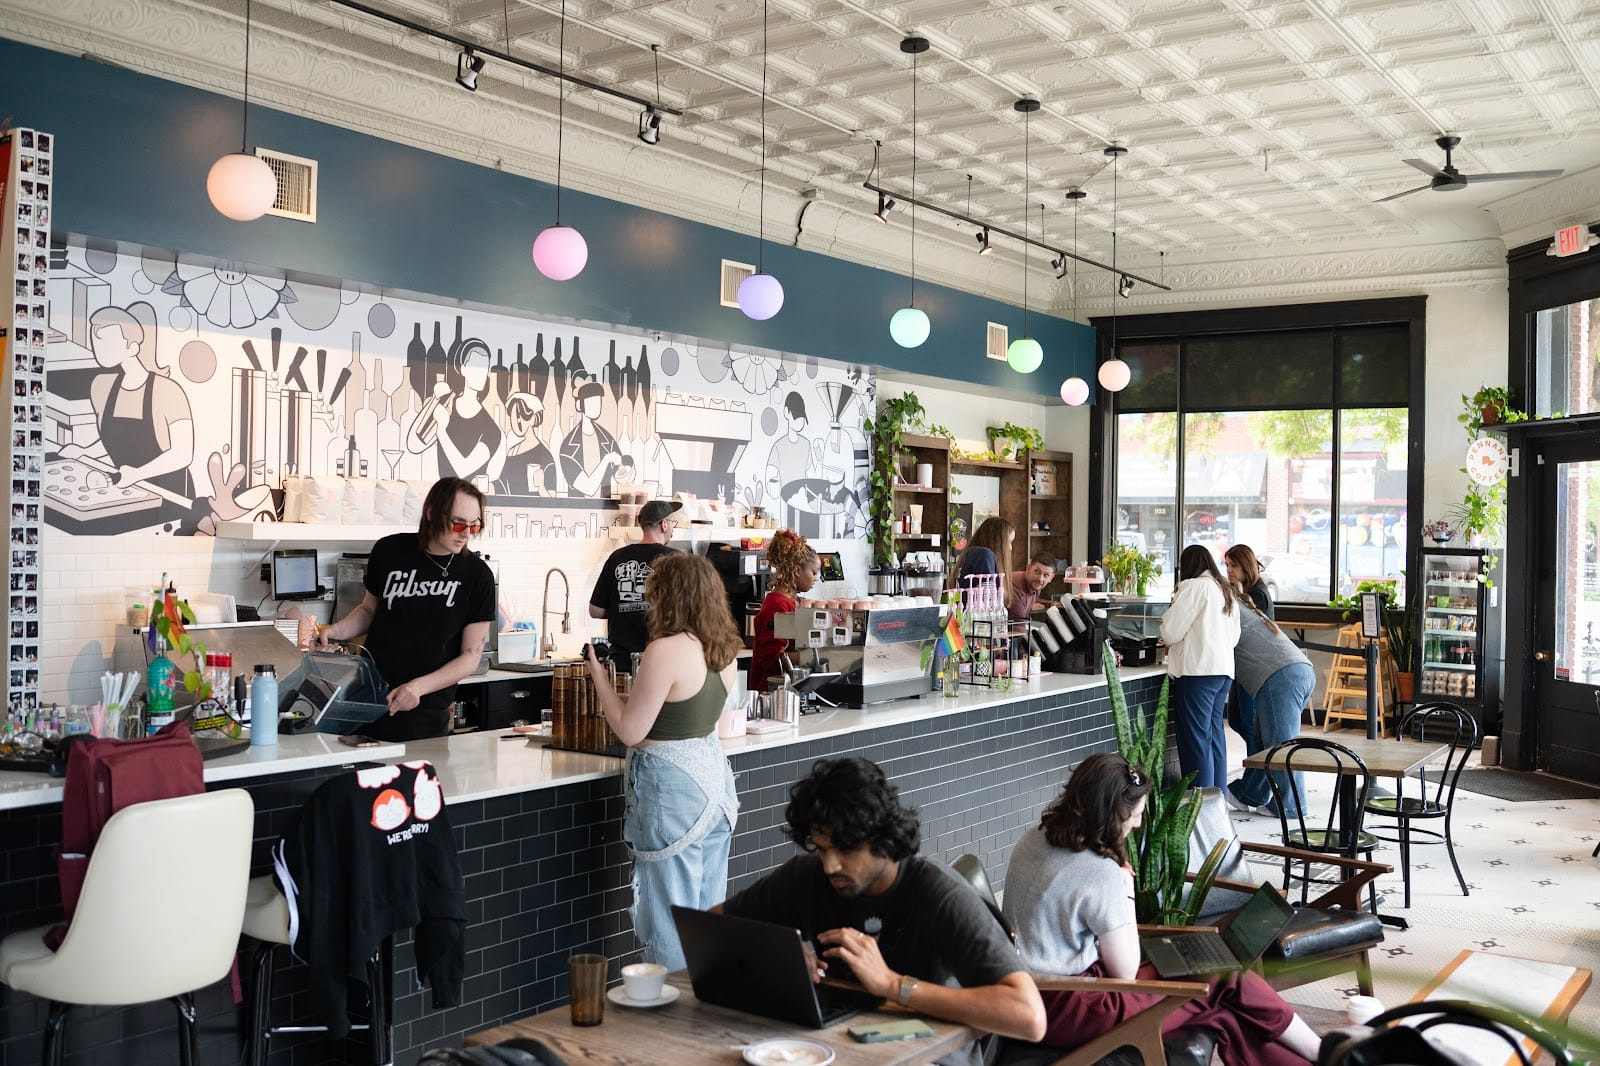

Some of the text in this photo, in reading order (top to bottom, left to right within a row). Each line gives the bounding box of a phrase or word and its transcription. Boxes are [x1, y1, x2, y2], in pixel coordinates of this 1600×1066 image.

[1559, 226, 1579, 255] EXIT
[1469, 440, 1508, 462] PENNANT
[1470, 467, 1505, 483] COFFEE
[383, 569, 461, 610] Gibson
